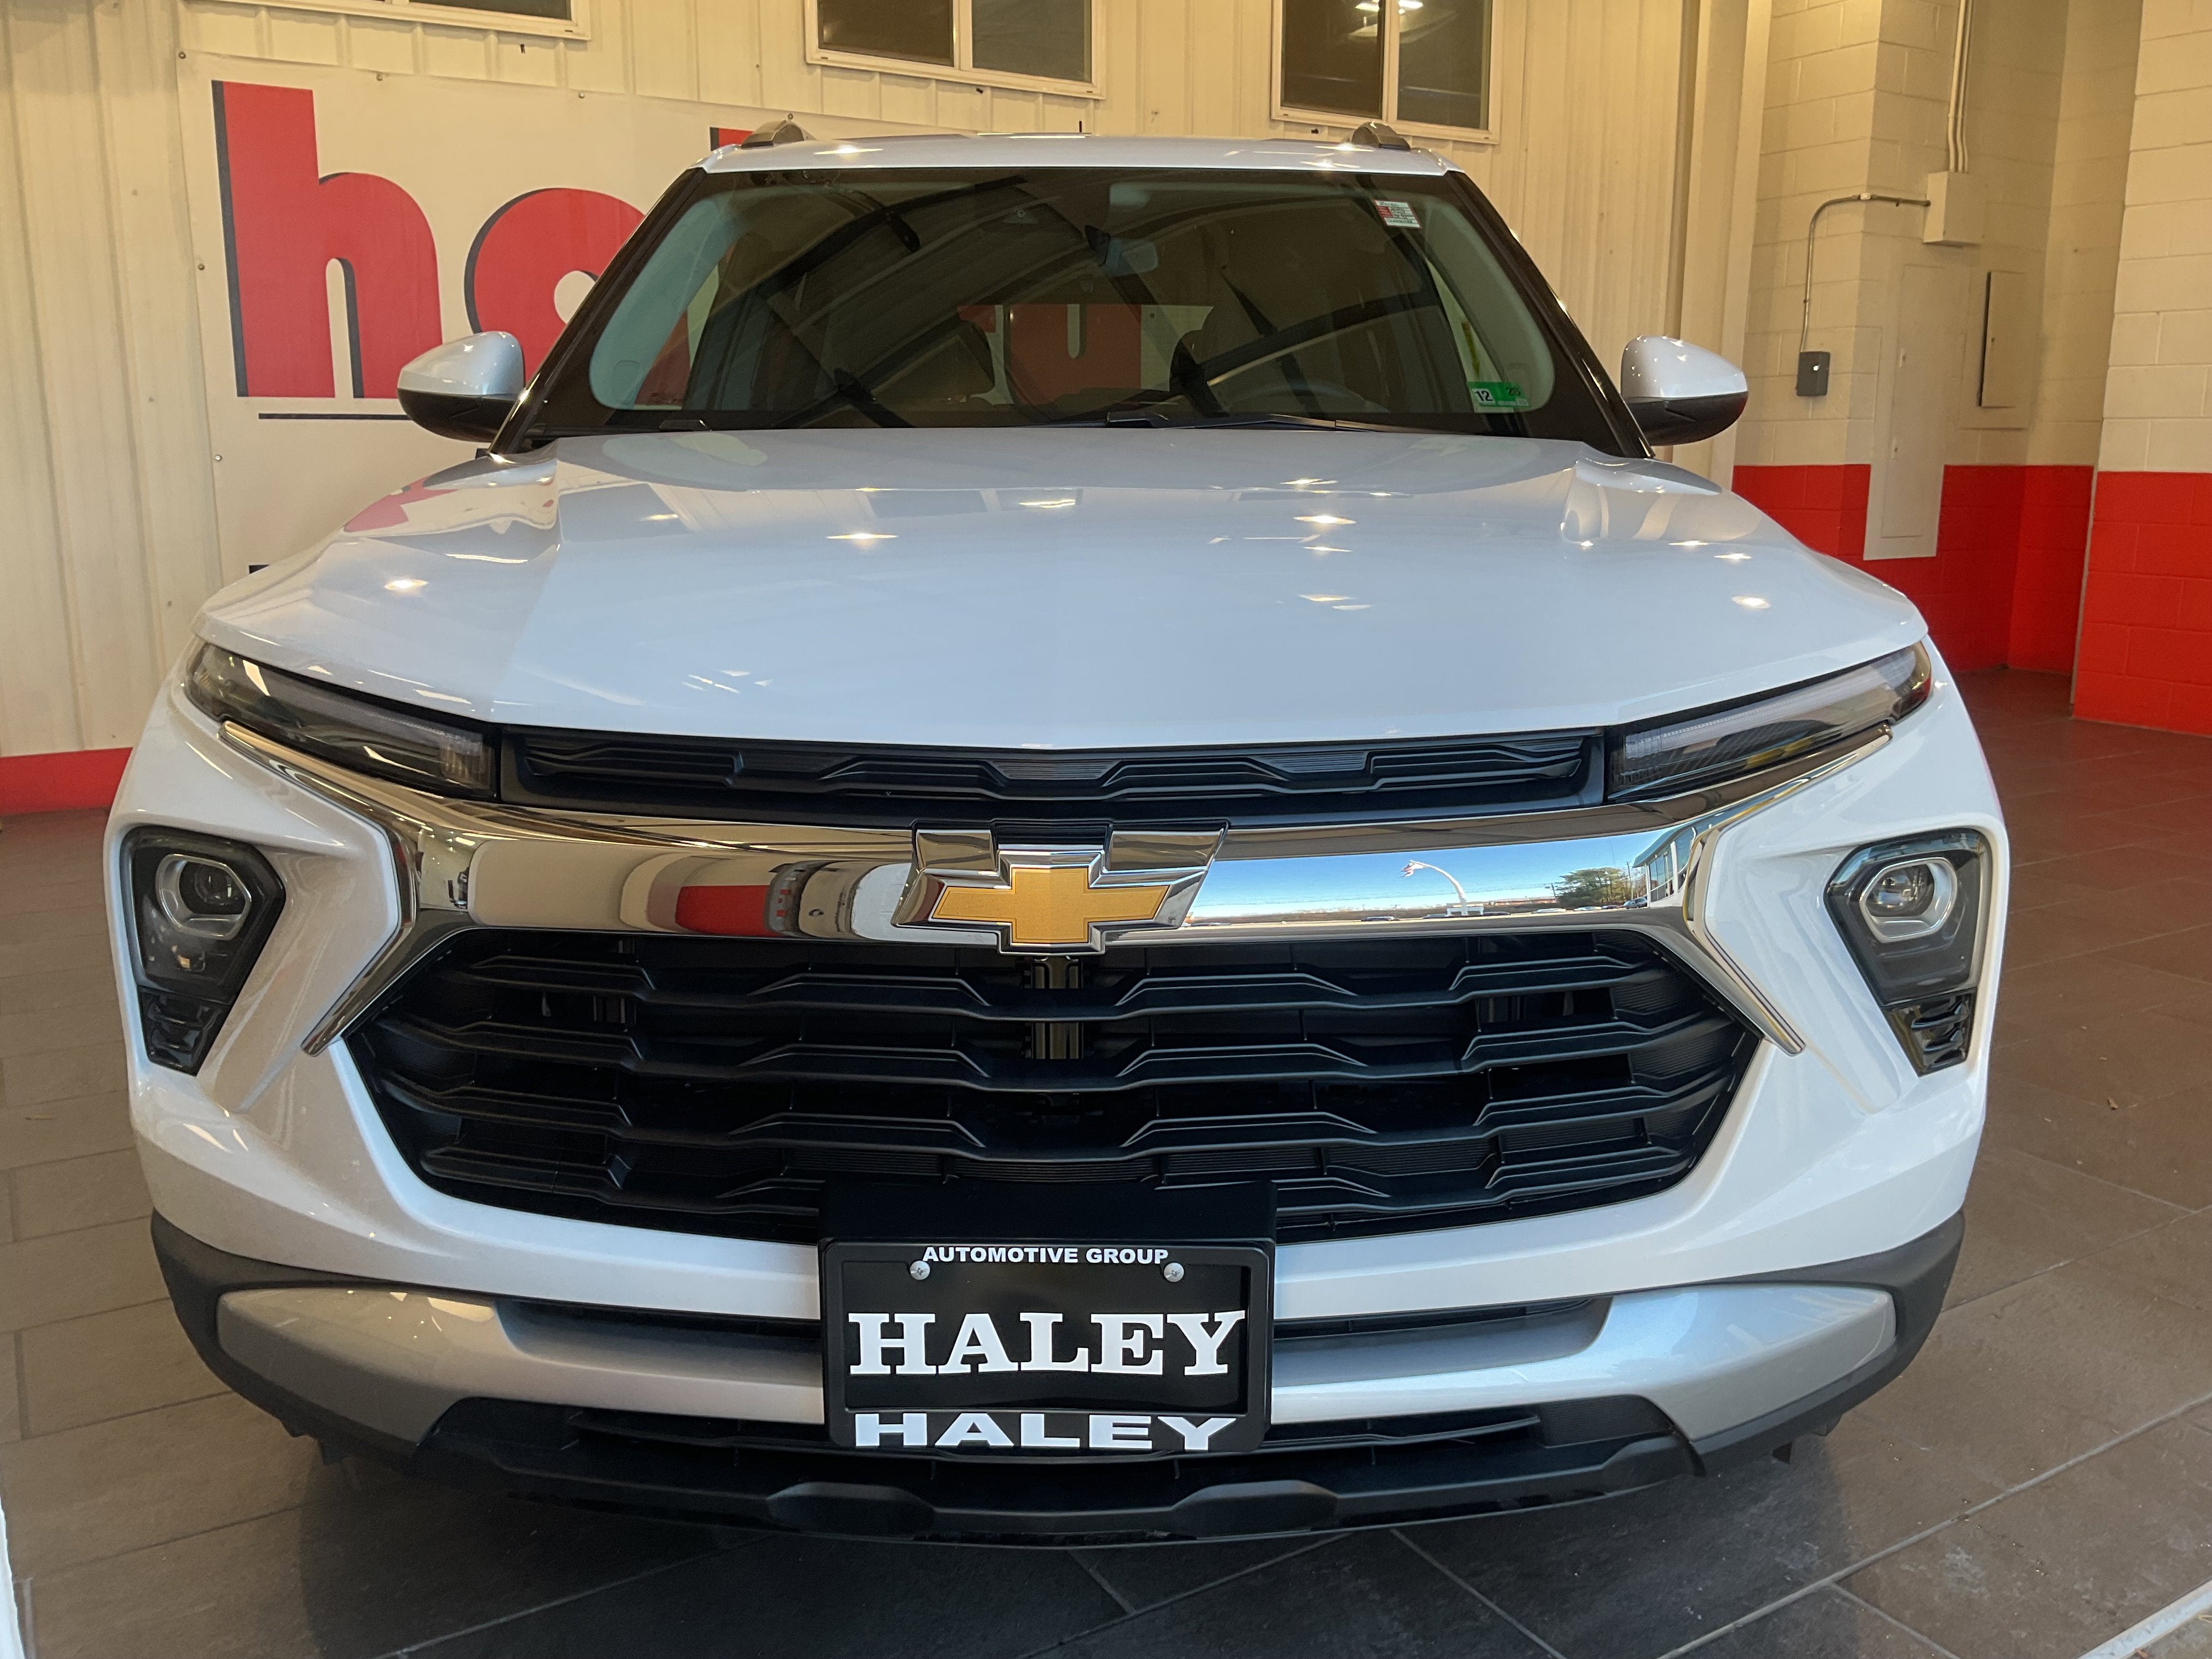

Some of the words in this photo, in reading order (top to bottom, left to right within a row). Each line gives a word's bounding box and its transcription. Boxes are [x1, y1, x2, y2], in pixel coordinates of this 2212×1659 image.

[1475, 390, 1493, 402] 12
[922, 1246, 1079, 1263] AUTOMOTIVE
[1086, 1248, 1169, 1265] GROUP
[848, 1310, 1245, 1376] HALEY
[855, 1413, 1237, 1451] HALEY
